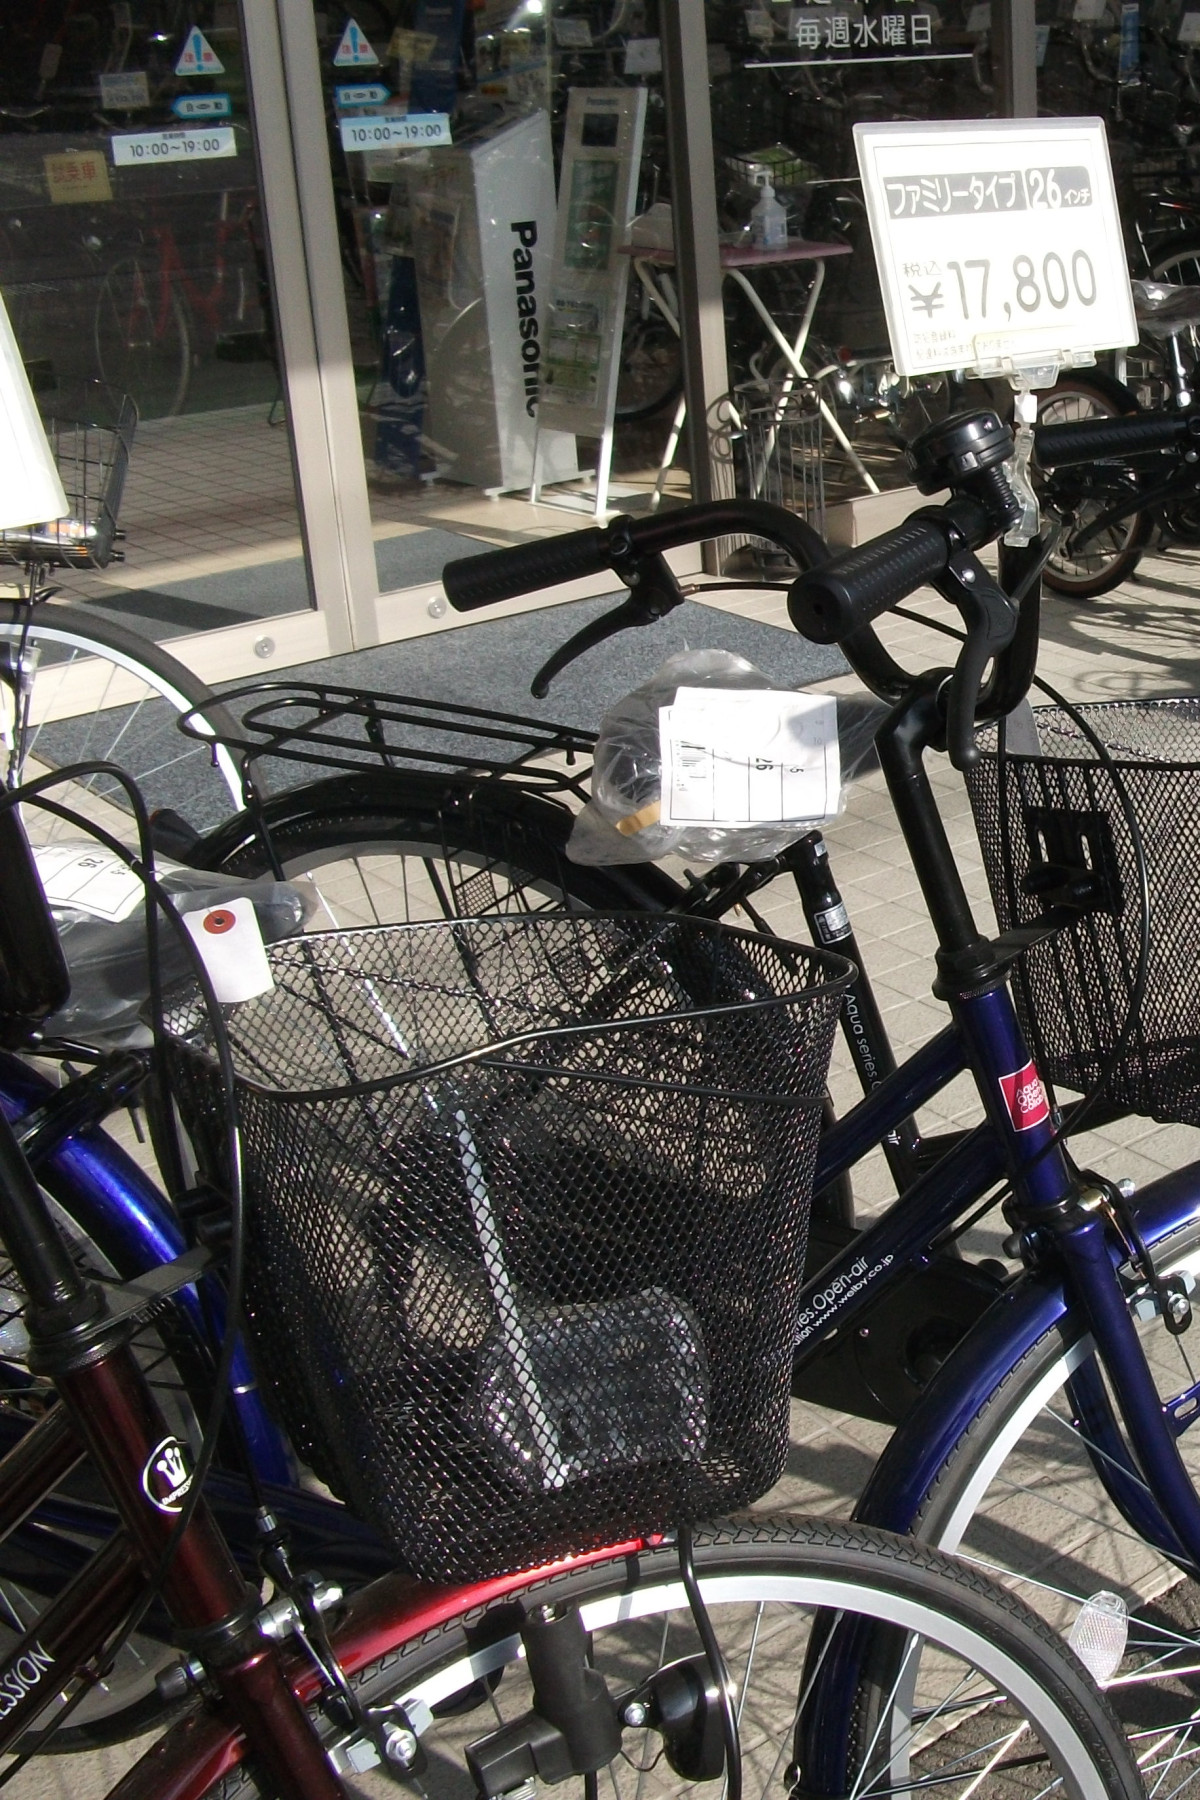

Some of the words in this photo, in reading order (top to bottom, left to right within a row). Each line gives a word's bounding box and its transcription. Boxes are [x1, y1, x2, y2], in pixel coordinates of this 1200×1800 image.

[795, 14, 932, 49] 毎週水曜日
[887, 172, 1017, 216] ファミリータイプ
[907, 249, 1097, 322] ¥17,800
[844, 993, 864, 1035] Aqua
[812, 1254, 894, 1327] www.welby.co.jp
